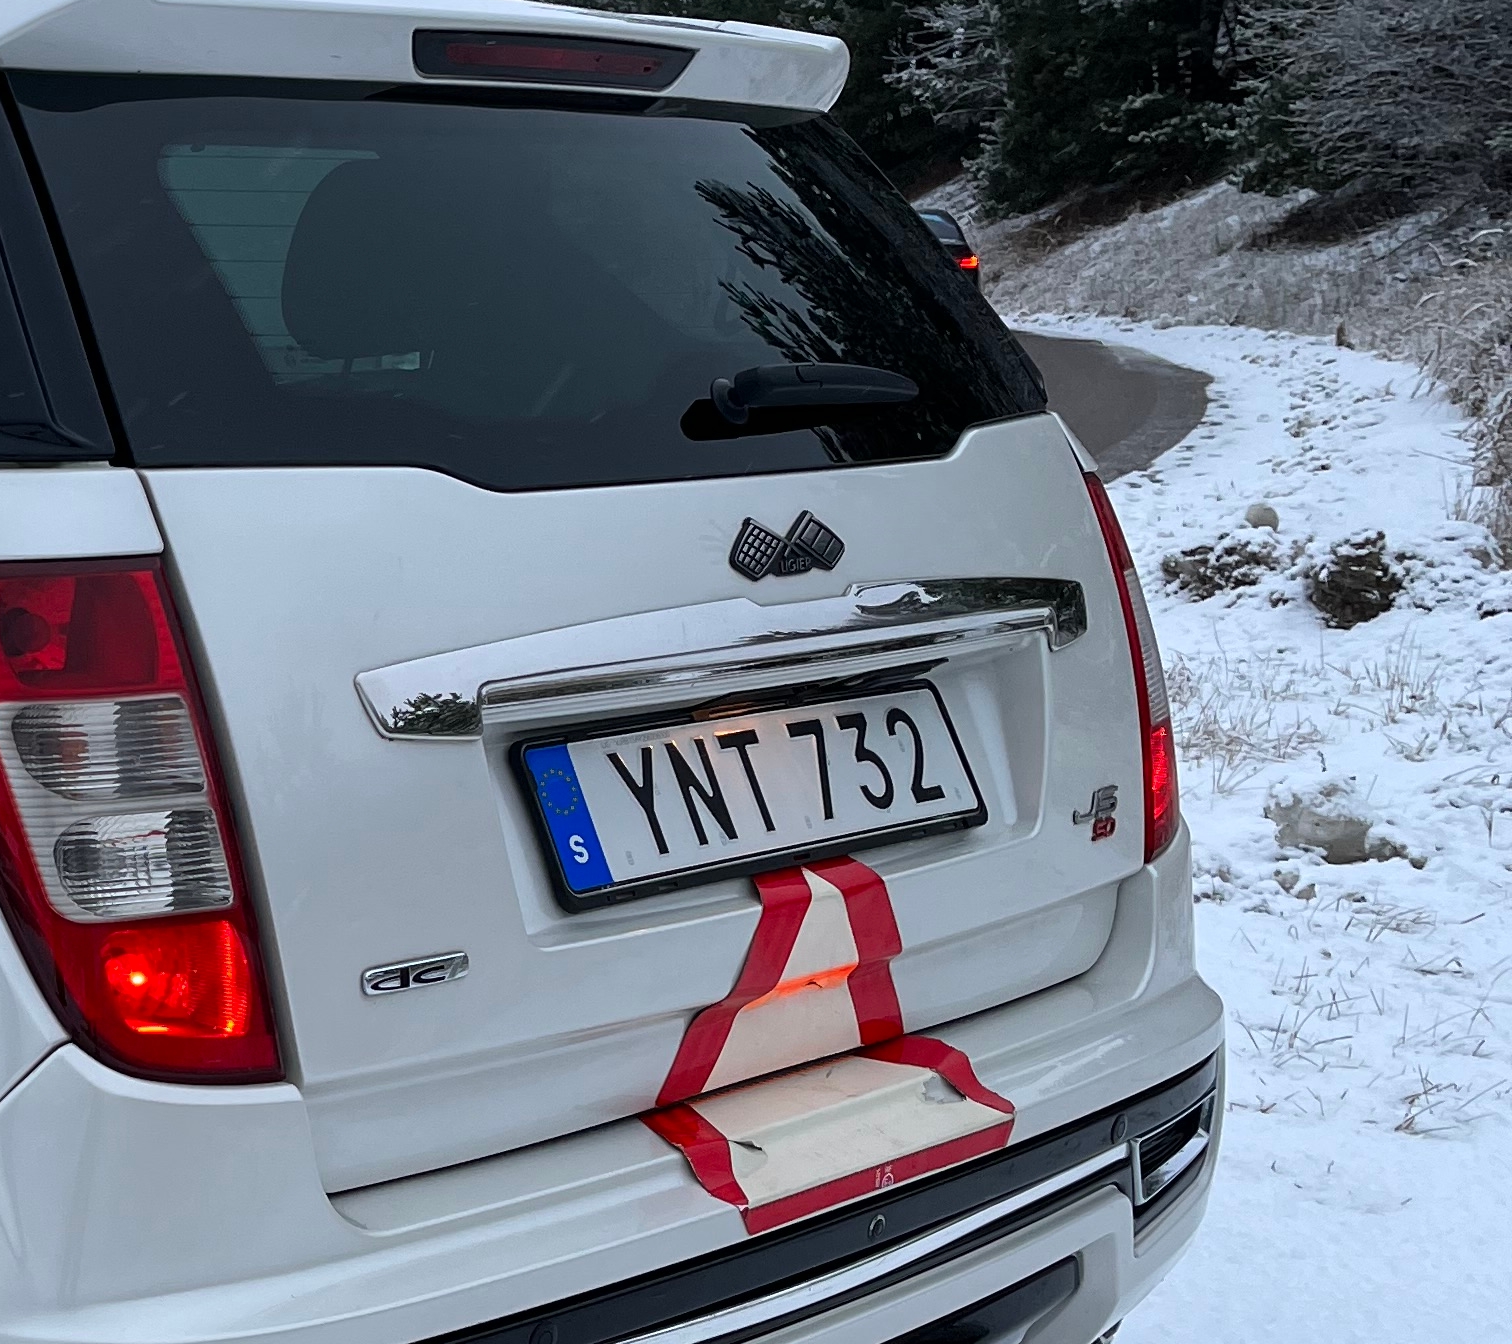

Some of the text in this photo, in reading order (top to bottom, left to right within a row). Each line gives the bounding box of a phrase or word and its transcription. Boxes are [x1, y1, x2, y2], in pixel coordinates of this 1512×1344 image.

[606, 707, 946, 855] YNT 732
[569, 835, 589, 864] S
